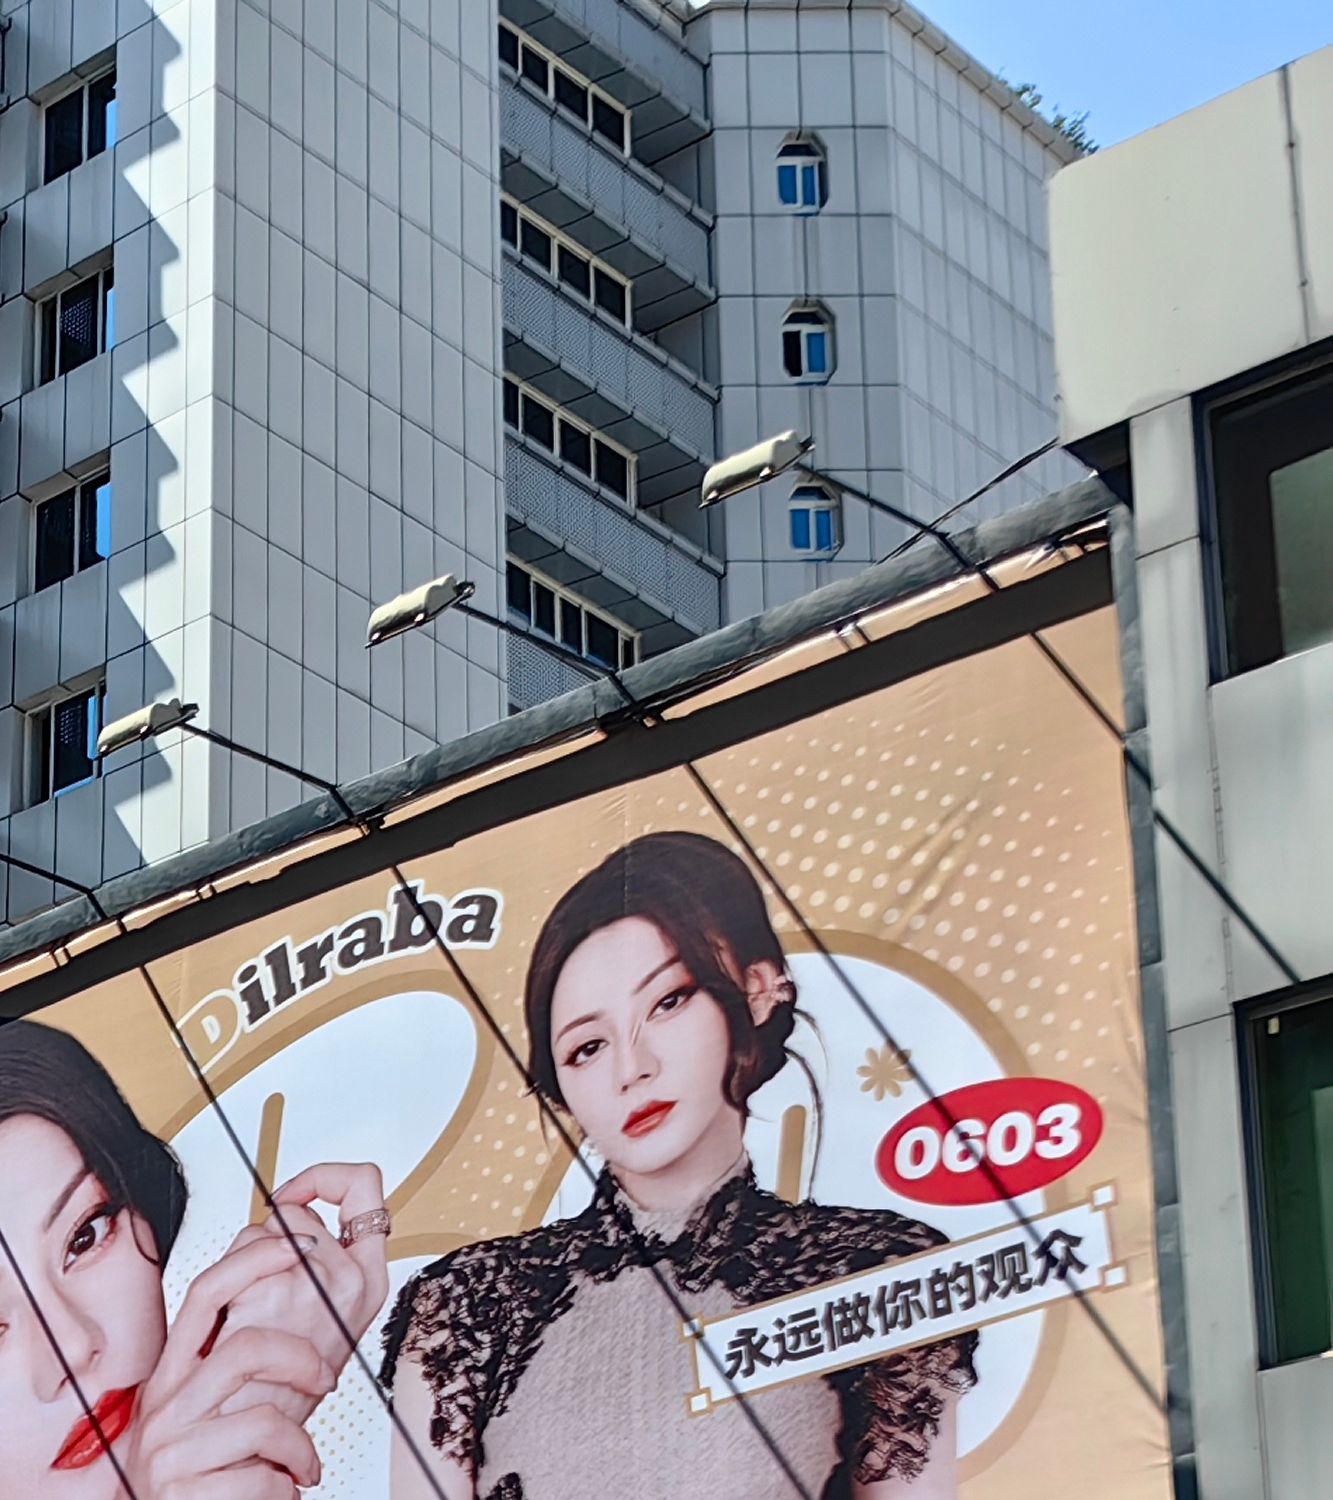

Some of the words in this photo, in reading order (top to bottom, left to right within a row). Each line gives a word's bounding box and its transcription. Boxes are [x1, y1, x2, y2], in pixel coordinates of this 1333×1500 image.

[175, 882, 501, 1076] Dilraba
[894, 1103, 1081, 1181] 0603
[724, 1229, 1090, 1382] 永远做你的观众
